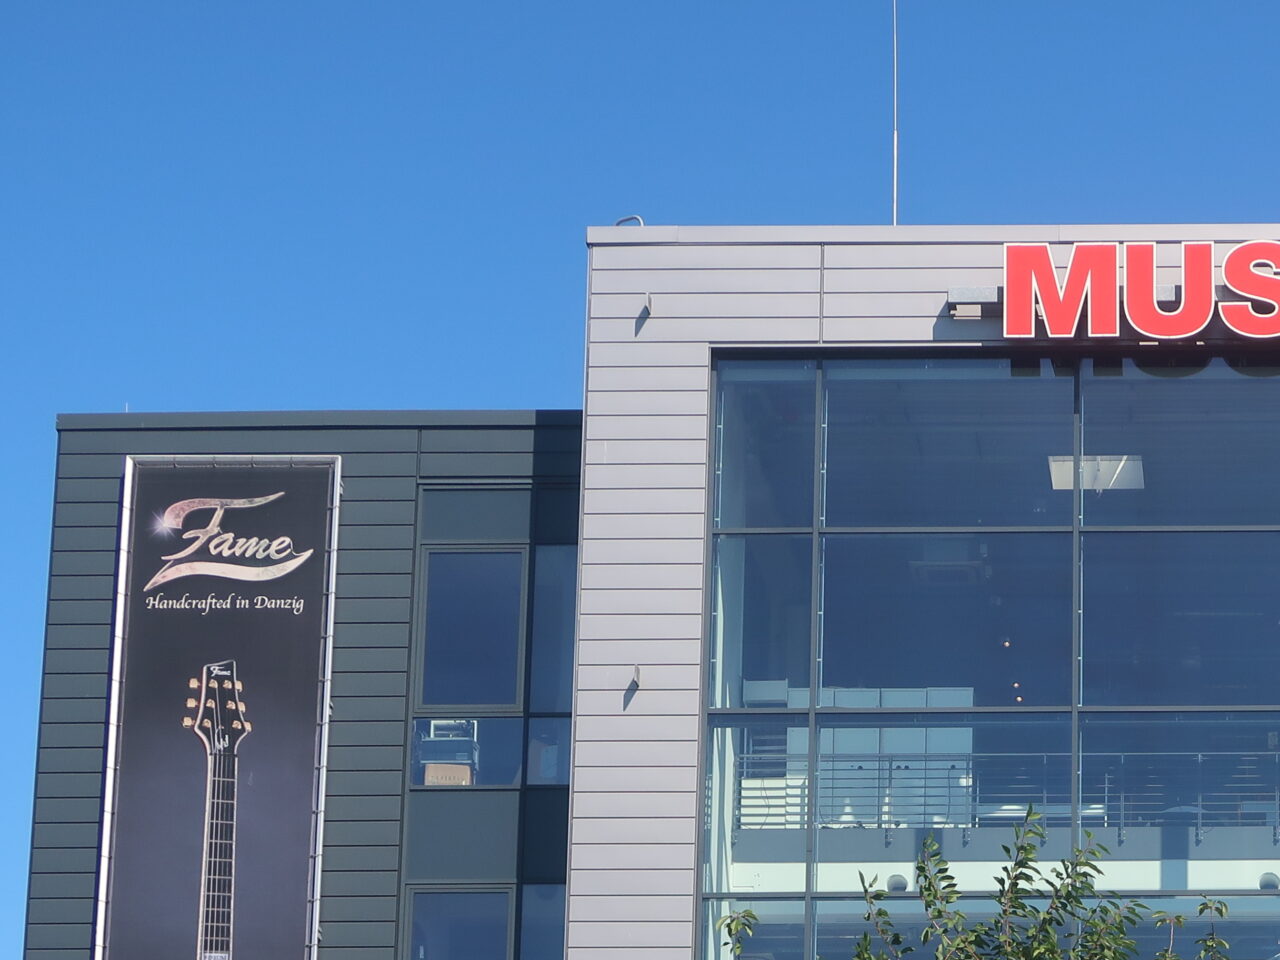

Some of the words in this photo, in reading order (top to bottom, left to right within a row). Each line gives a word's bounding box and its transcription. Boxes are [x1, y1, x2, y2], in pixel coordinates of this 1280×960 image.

[153, 492, 313, 575] Fame
[146, 593, 235, 615] Handcrafted
[236, 596, 250, 609] in
[254, 595, 305, 615] Danzig
